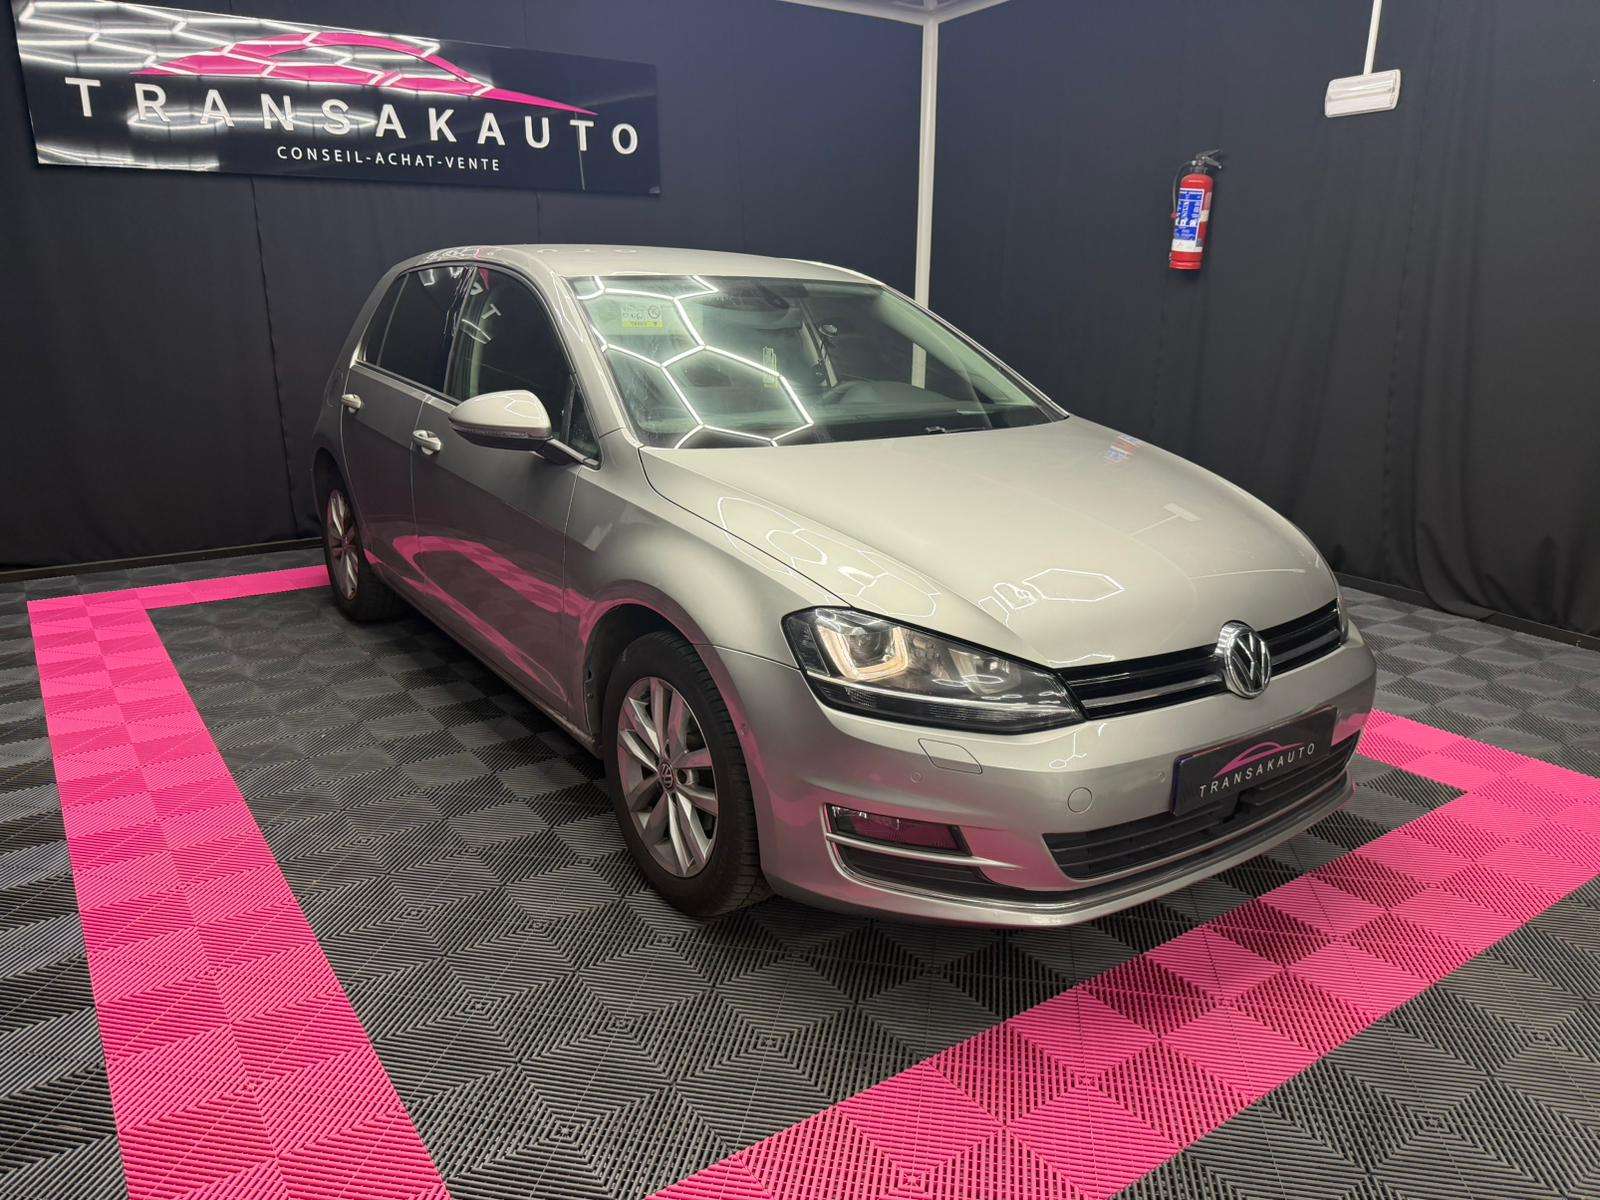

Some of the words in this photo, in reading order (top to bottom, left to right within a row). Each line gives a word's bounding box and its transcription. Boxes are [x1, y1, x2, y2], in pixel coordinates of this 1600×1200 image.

[65, 77, 639, 155] TRANSAKAUTO
[277, 145, 501, 172] CONSEIL-ACHAT-VENTE
[1200, 743, 1315, 797] TRANSAKAUTO
